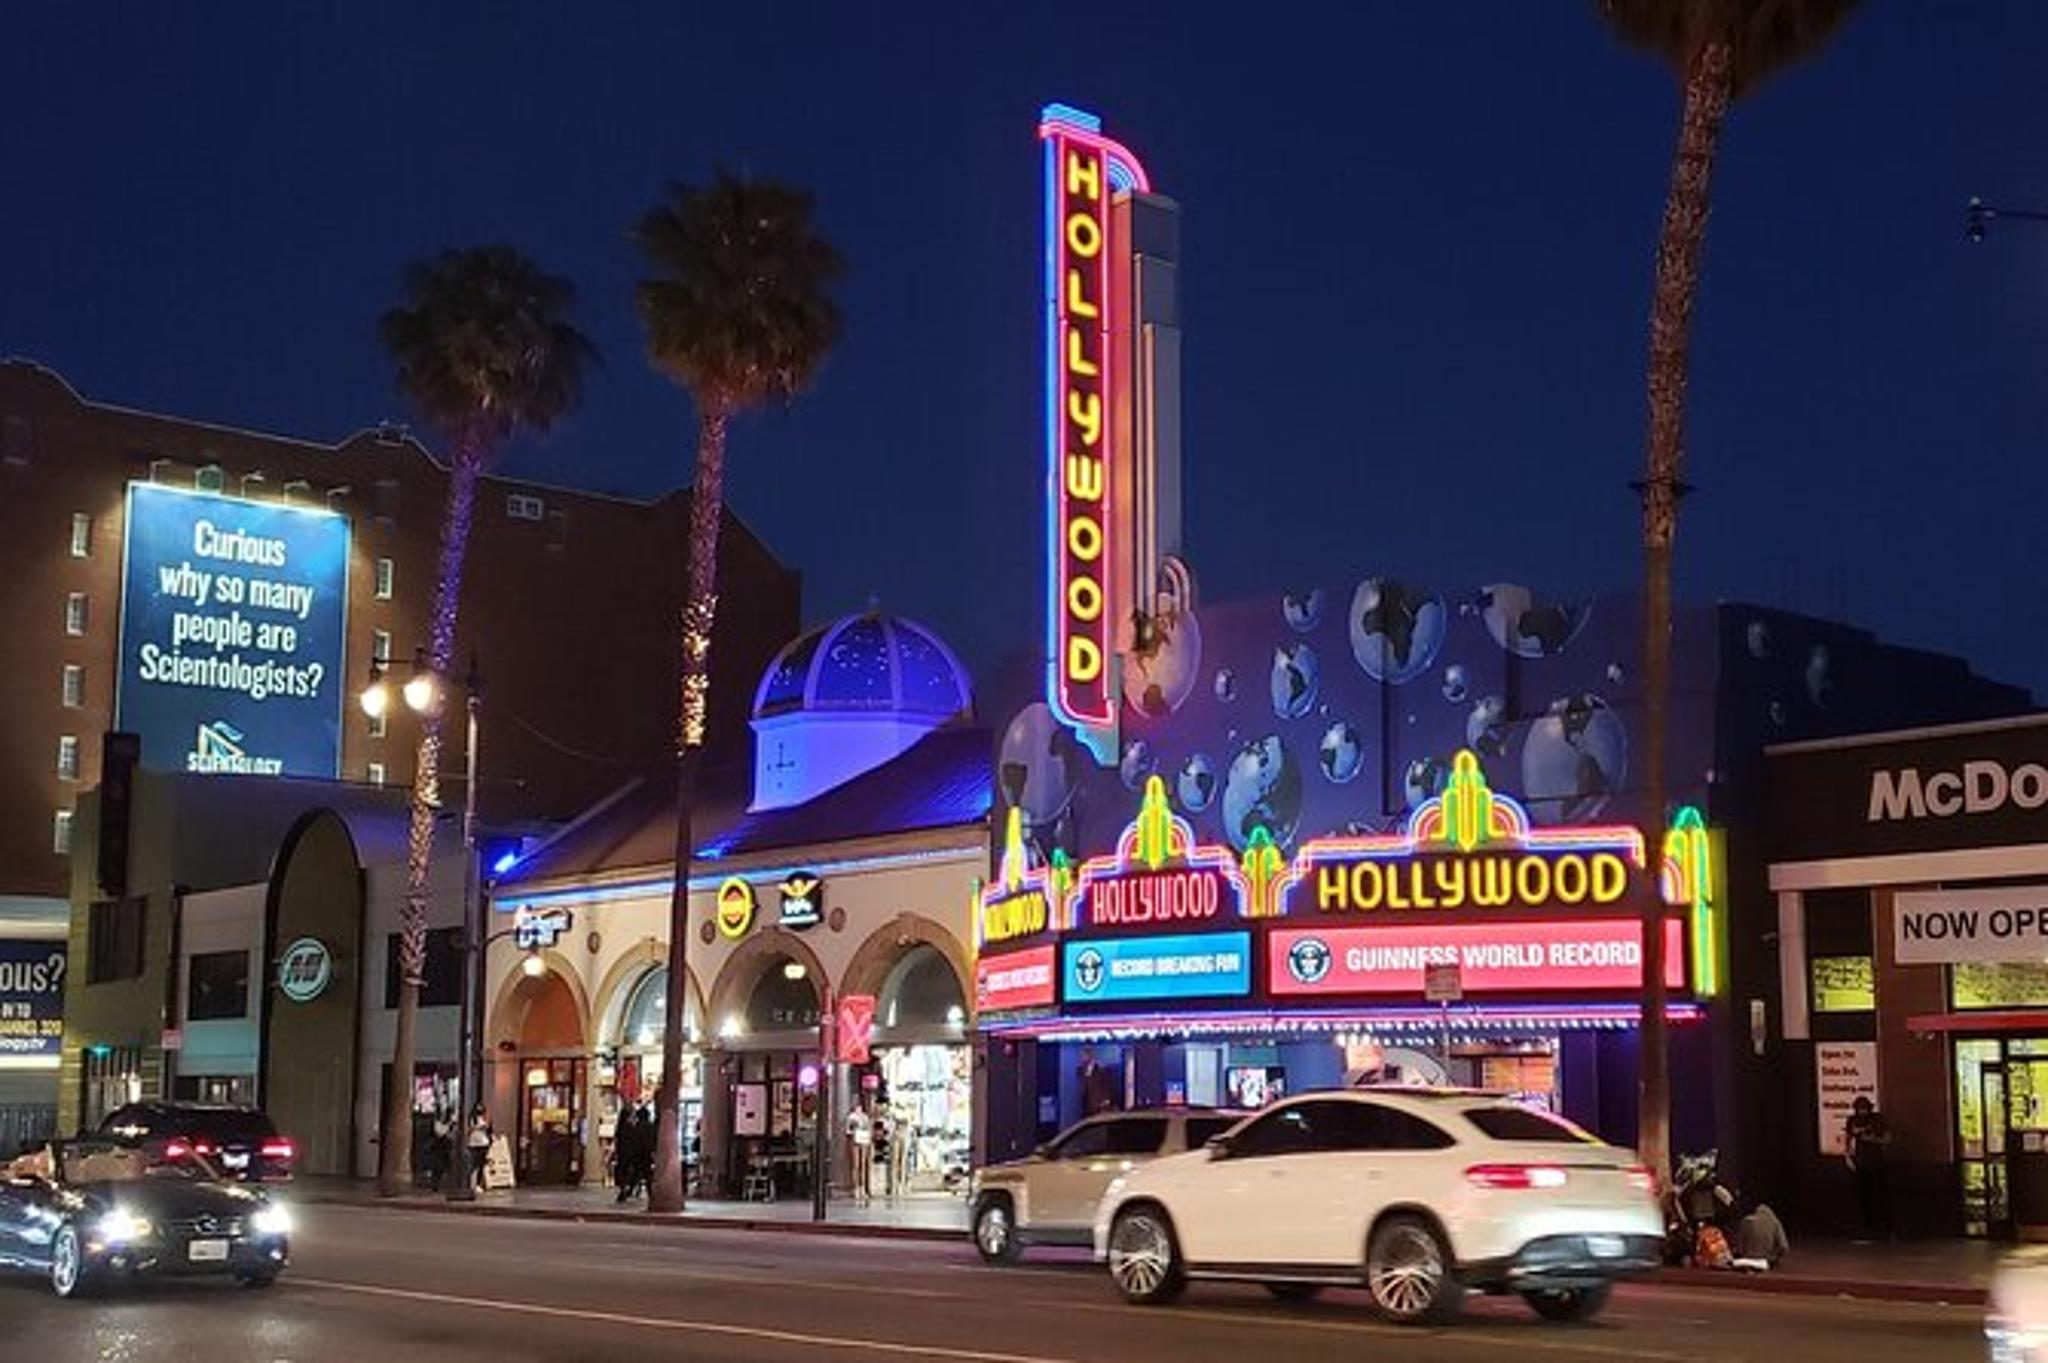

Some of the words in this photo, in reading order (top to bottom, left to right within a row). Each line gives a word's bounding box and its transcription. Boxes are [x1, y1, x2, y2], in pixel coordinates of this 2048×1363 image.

[1067, 149, 1102, 683] HOLLYWOOD
[194, 520, 285, 566] Curious
[160, 561, 212, 605] why
[216, 575, 244, 603] so
[250, 579, 313, 619] many
[173, 611, 252, 651] people
[256, 623, 296, 652] are
[140, 644, 323, 699] Scientologists?
[1868, 760, 2048, 821] McDo
[1093, 872, 1219, 924] HOLLYWOOD
[1319, 853, 1628, 910] HOLLYWOOD
[1902, 909, 1979, 940] NOW
[1988, 906, 2048, 939] OPE
[0, 952, 65, 993] ous?
[1216, 952, 1240, 974] FUN
[1346, 945, 1459, 971] GUINNESS
[1461, 943, 1544, 968] WORLD
[1549, 940, 1641, 967] RECORD
